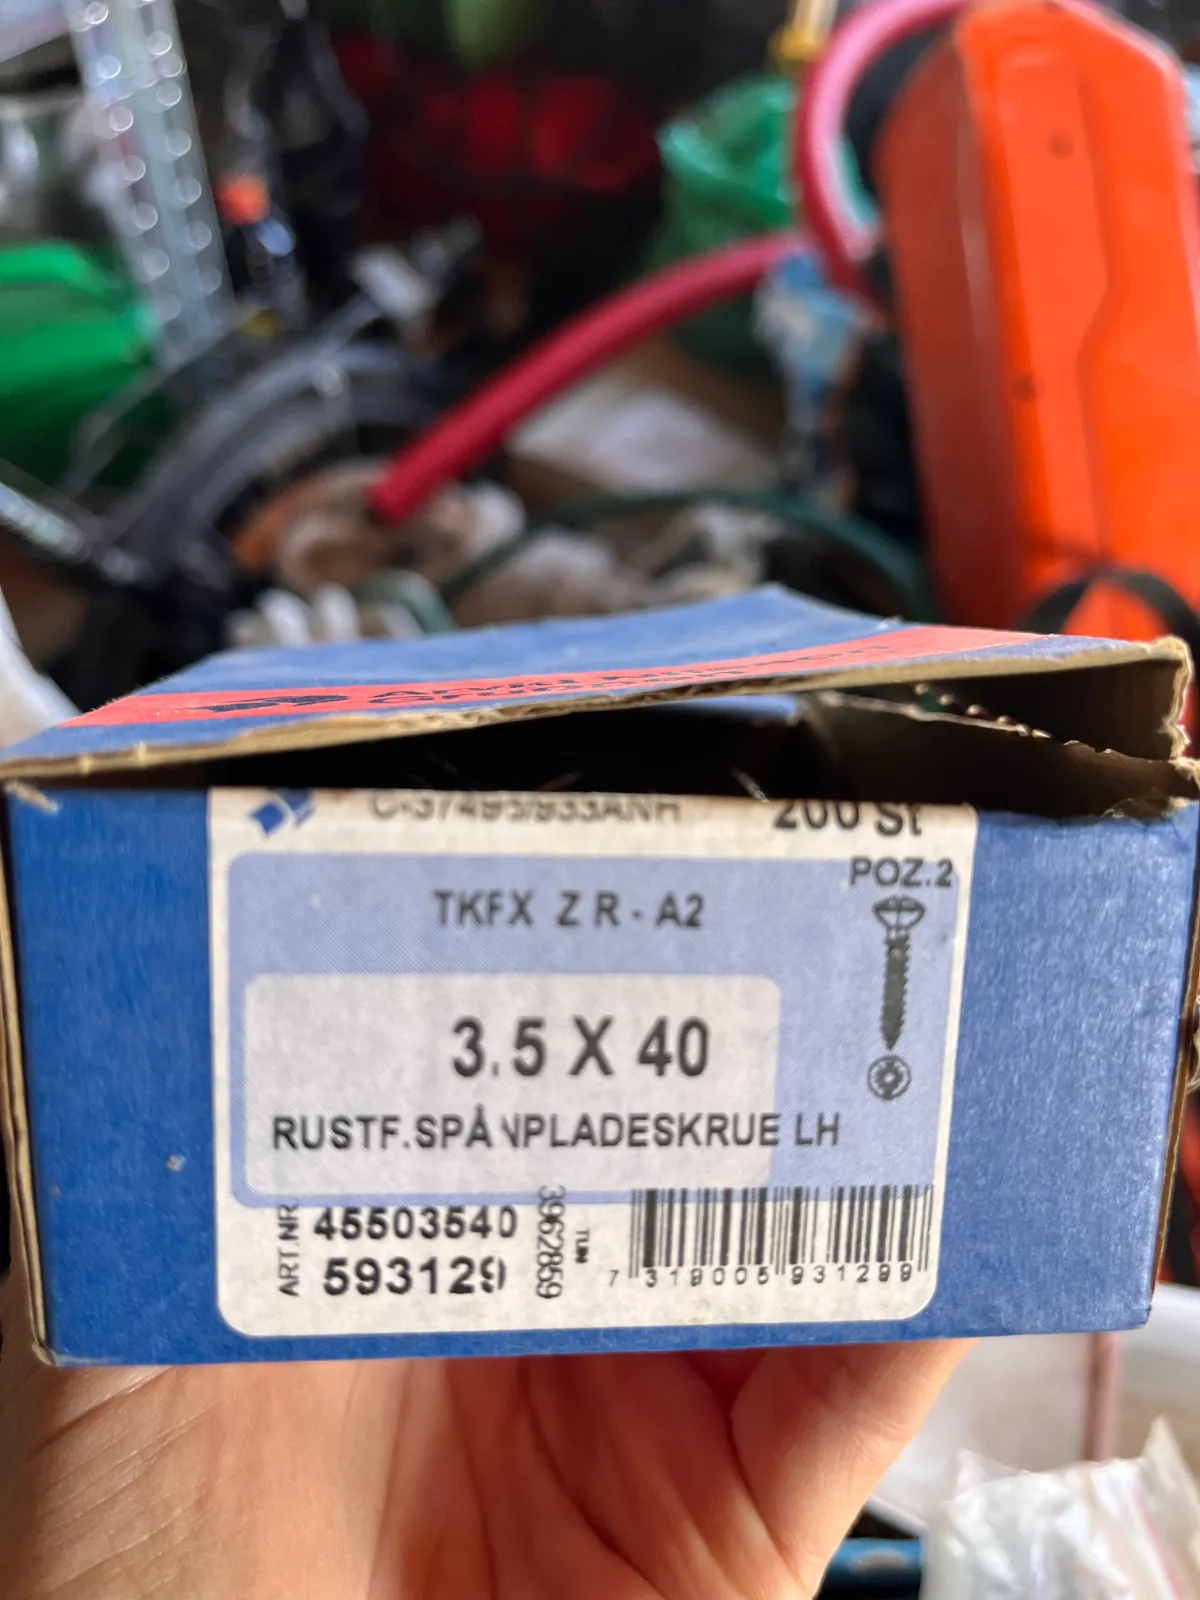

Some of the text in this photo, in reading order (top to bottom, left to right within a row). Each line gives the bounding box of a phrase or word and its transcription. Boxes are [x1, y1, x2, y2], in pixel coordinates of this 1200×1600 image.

[774, 800, 859, 829] 200
[851, 857, 953, 887] POZ.2
[434, 889, 535, 927] TKFX
[655, 892, 704, 927] A2
[453, 1015, 708, 1078] 3.5 X 40
[795, 1112, 839, 1146] LH
[314, 1205, 517, 1240] 45503540
[536, 1185, 566, 1299] 3962859
[323, 1255, 507, 1296] 593129
